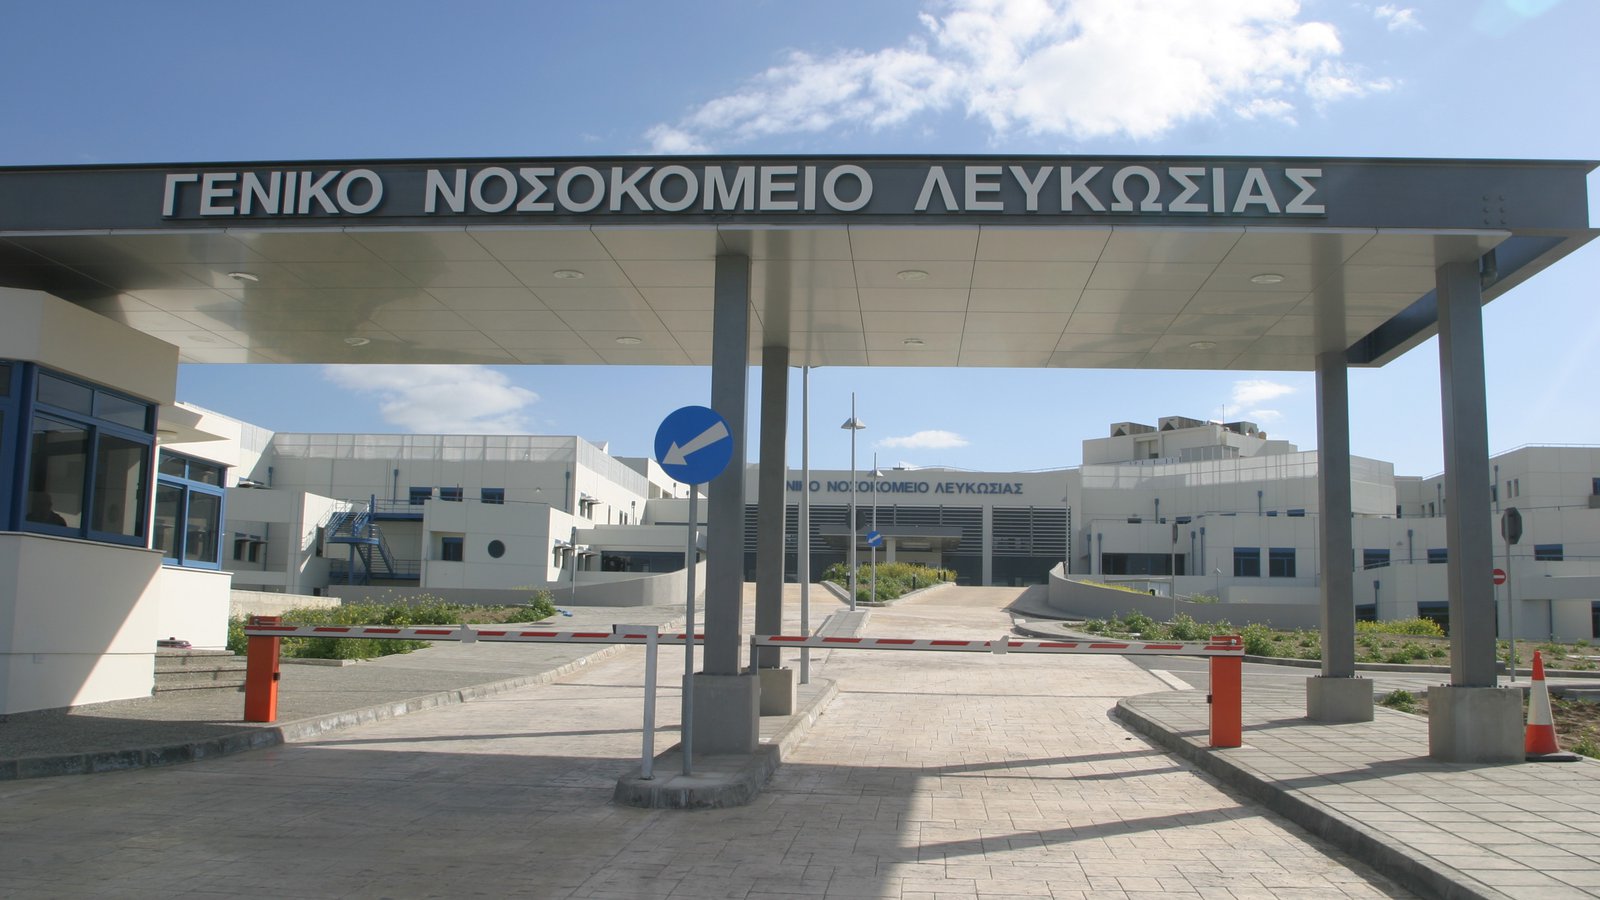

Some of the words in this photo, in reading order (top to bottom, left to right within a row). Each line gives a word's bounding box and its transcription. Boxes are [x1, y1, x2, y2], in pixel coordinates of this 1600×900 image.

[162, 168, 384, 216] ΓΕΝΙΚΟ
[424, 164, 874, 213] ΝΟΣΟΚΟΜΕΙΟ
[914, 165, 1326, 215] ΛΕΥΚΩΣΙΑΣ
[935, 482, 1023, 494] ΛΕΥΚΩΣΙΑΣ
